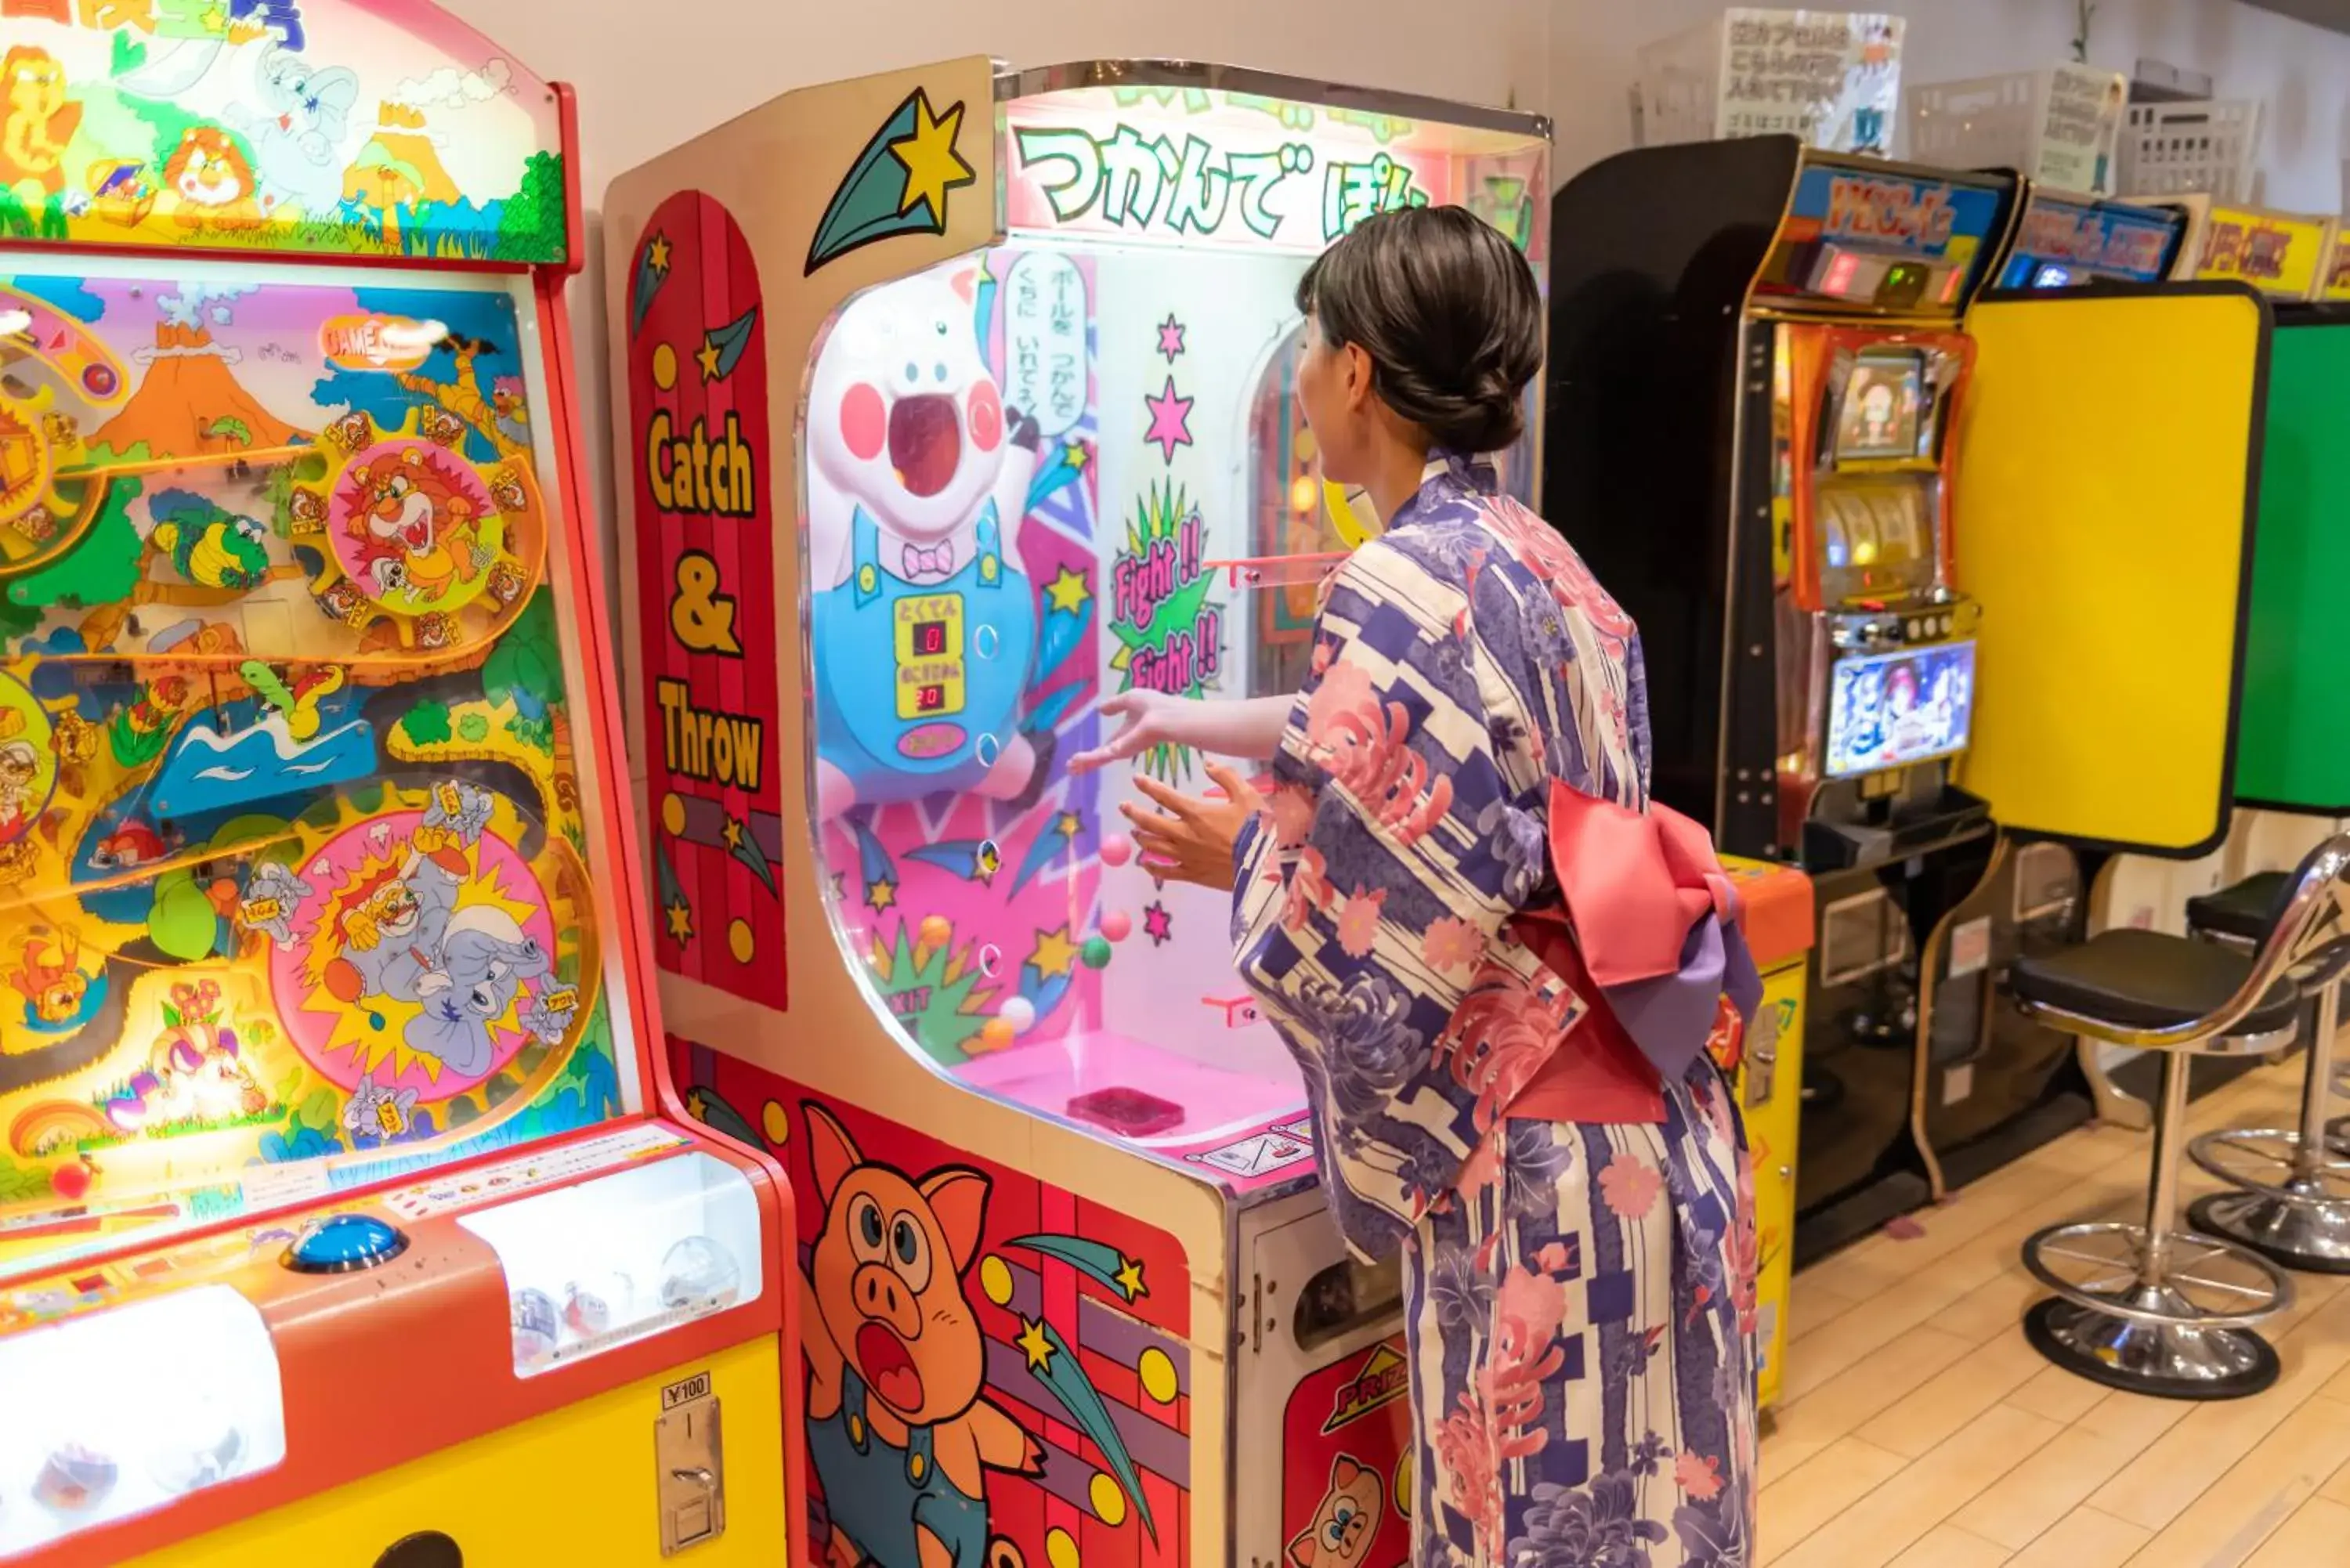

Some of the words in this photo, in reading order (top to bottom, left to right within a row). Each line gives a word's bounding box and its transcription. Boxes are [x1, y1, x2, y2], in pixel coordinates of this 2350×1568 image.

[1013, 123, 1314, 239] つかんで
[647, 408, 755, 518] Catch
[670, 548, 743, 659] &
[927, 628, 940, 652] 0
[656, 676, 762, 793] Throw
[668, 1377, 704, 1403] ¥100
[1337, 1361, 1408, 1415] PRIZ
